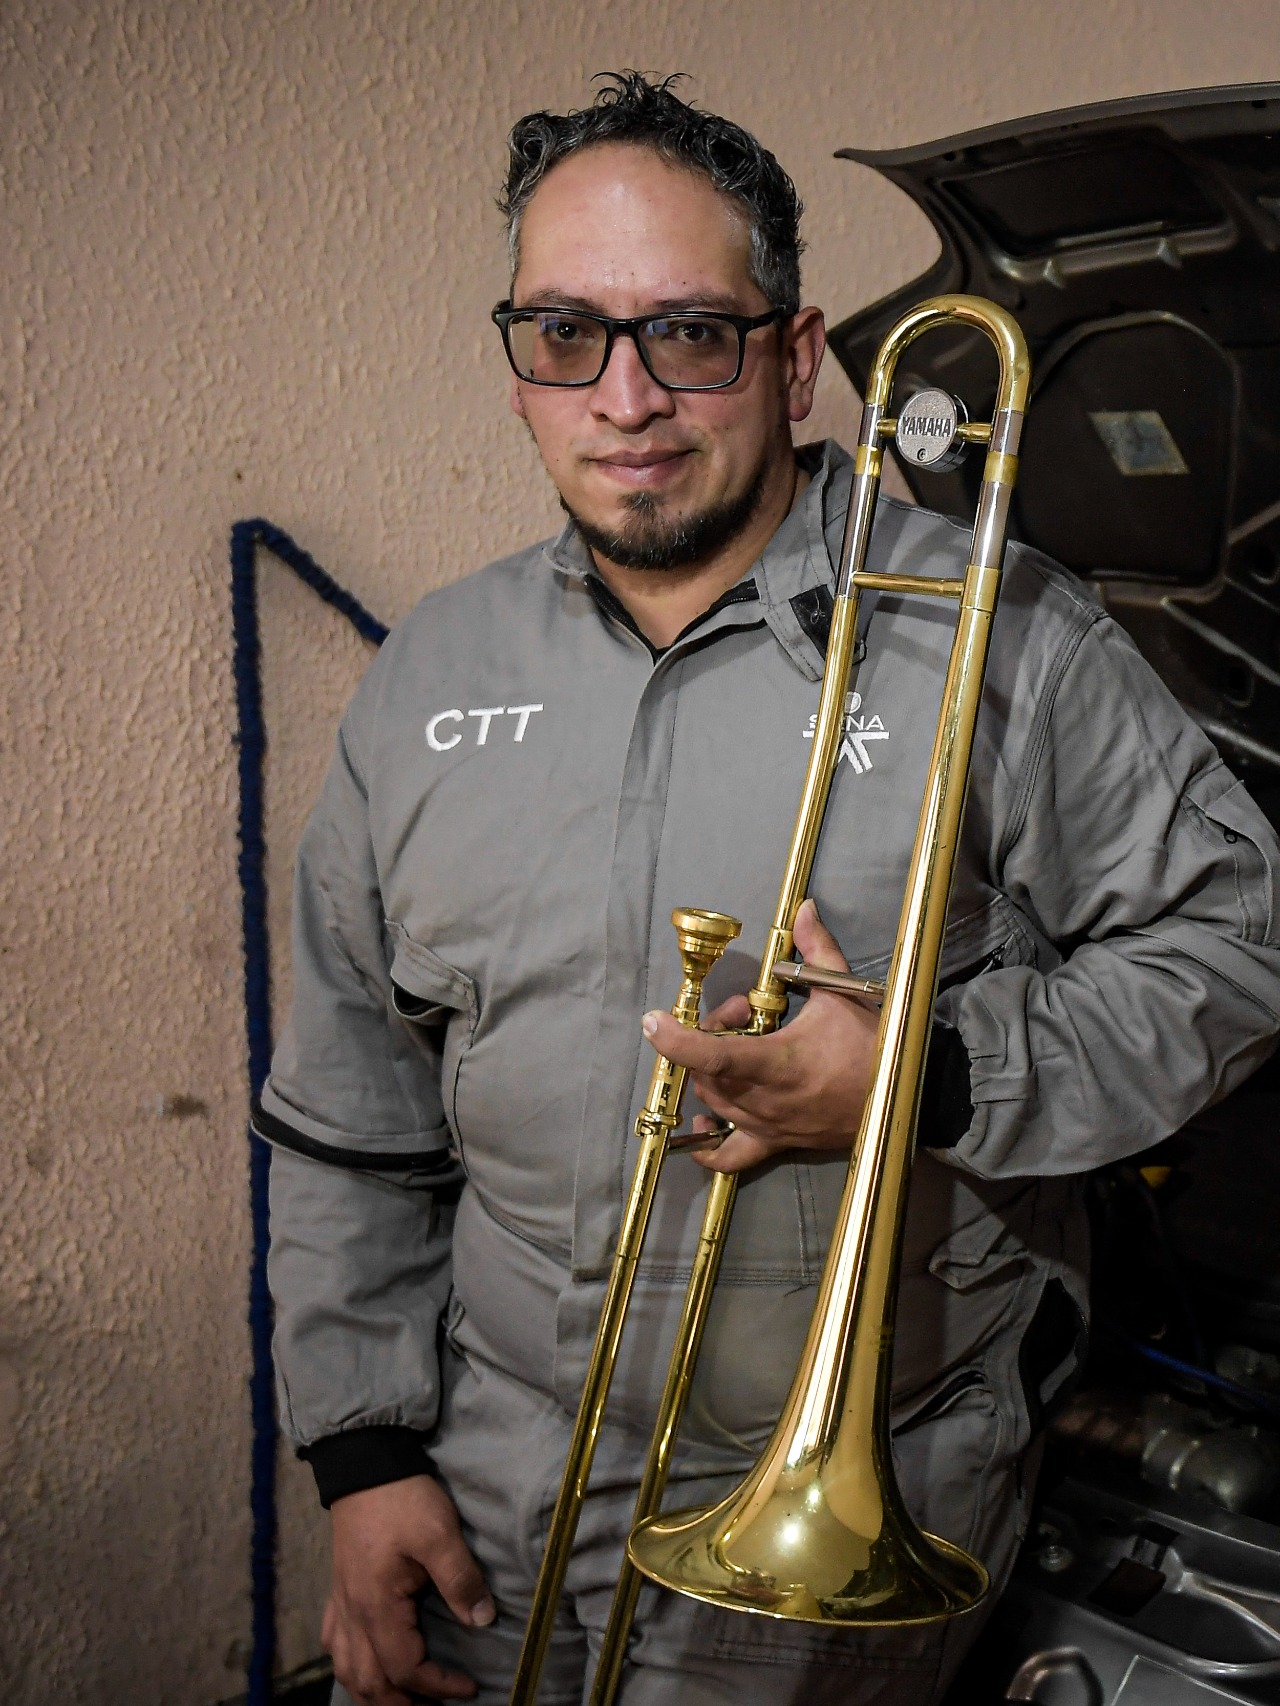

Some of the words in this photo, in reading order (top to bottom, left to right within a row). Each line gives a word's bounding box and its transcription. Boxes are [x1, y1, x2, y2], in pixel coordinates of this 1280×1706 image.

[902, 416, 951, 437] YAMAHA
[425, 703, 544, 752] CTT
[808, 713, 885, 731] SNA
